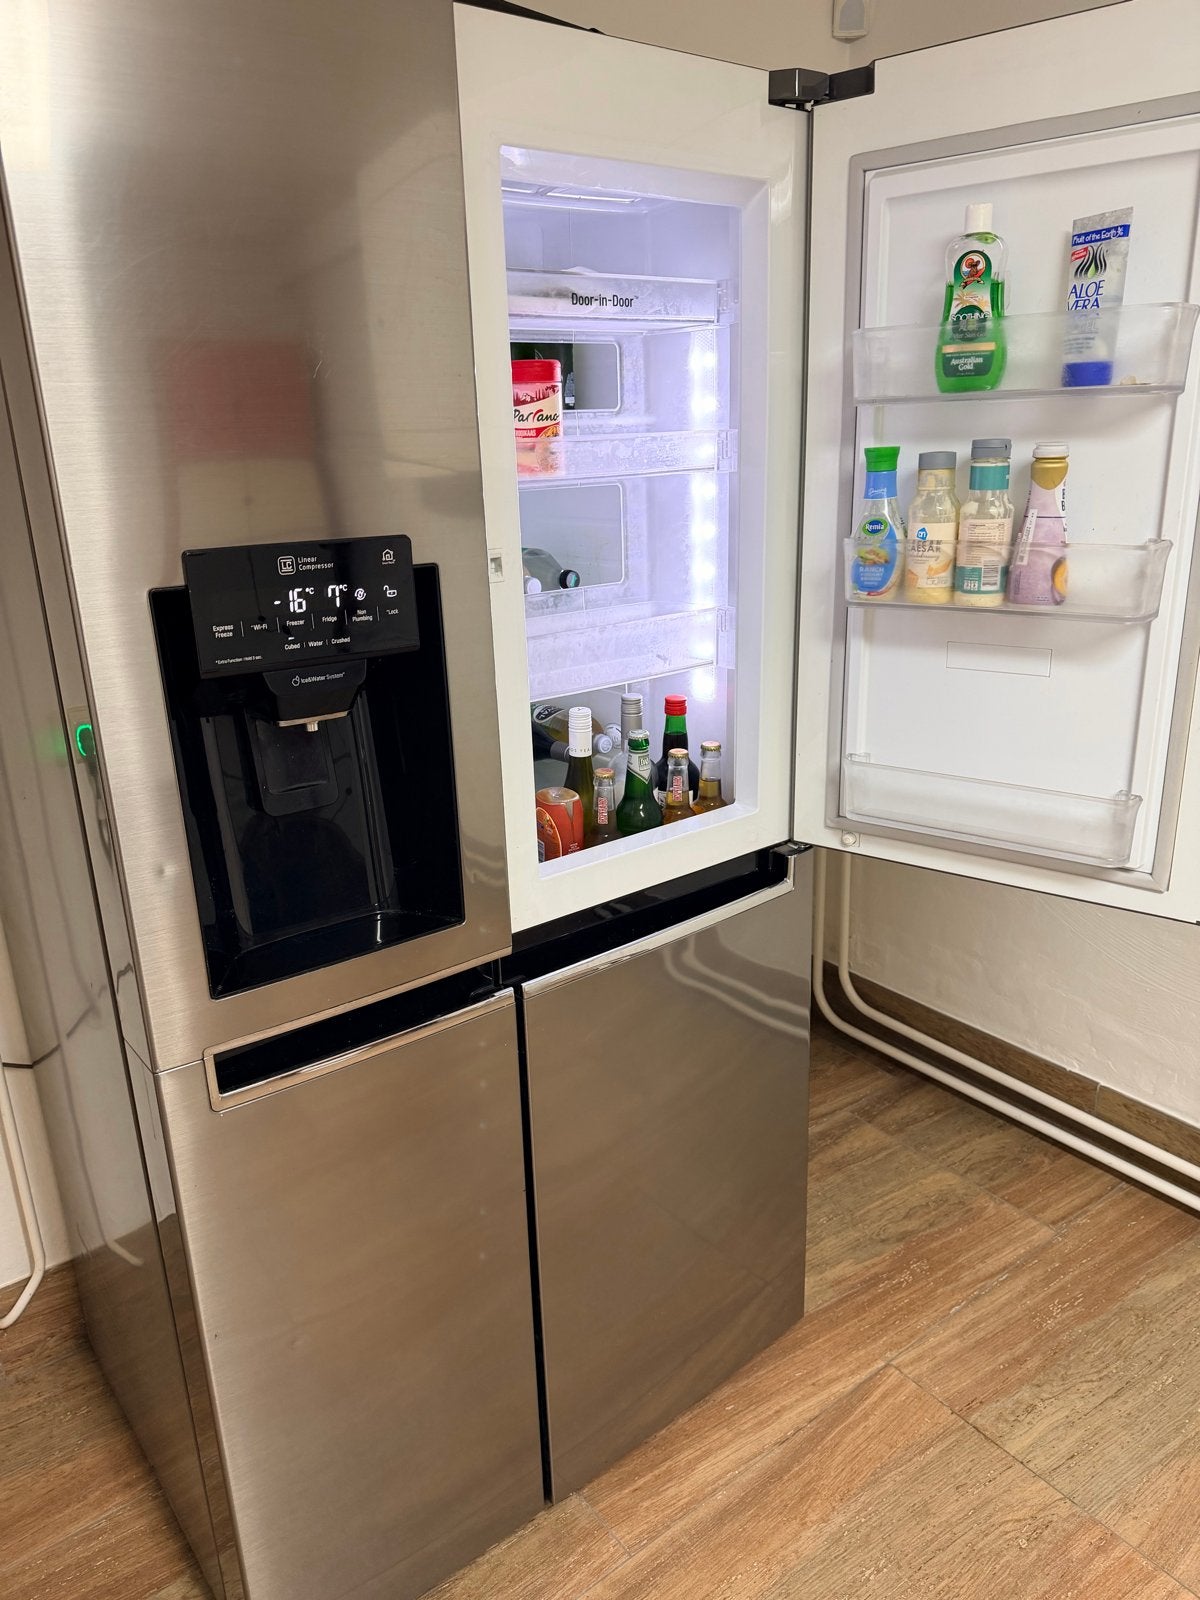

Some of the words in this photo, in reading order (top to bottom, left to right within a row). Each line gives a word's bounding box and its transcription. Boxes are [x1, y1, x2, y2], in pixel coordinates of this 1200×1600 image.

[1072, 234, 1085, 245] Fruit
[1091, 232, 1101, 241] the
[1101, 228, 1118, 240] Earth
[1067, 279, 1105, 300] ALOE
[950, 356, 983, 366] Australian
[958, 363, 974, 371] Gold
[865, 522, 885, 532] Remia
[297, 556, 318, 564] Linear
[298, 562, 335, 571] Compressor
[286, 619, 305, 627] Freezer
[321, 615, 338, 623] Fridge
[212, 624, 234, 632] Express
[215, 631, 233, 639] Freeze
[284, 642, 301, 651] Cubed
[307, 640, 324, 648] Water
[331, 636, 351, 645] Crushed
